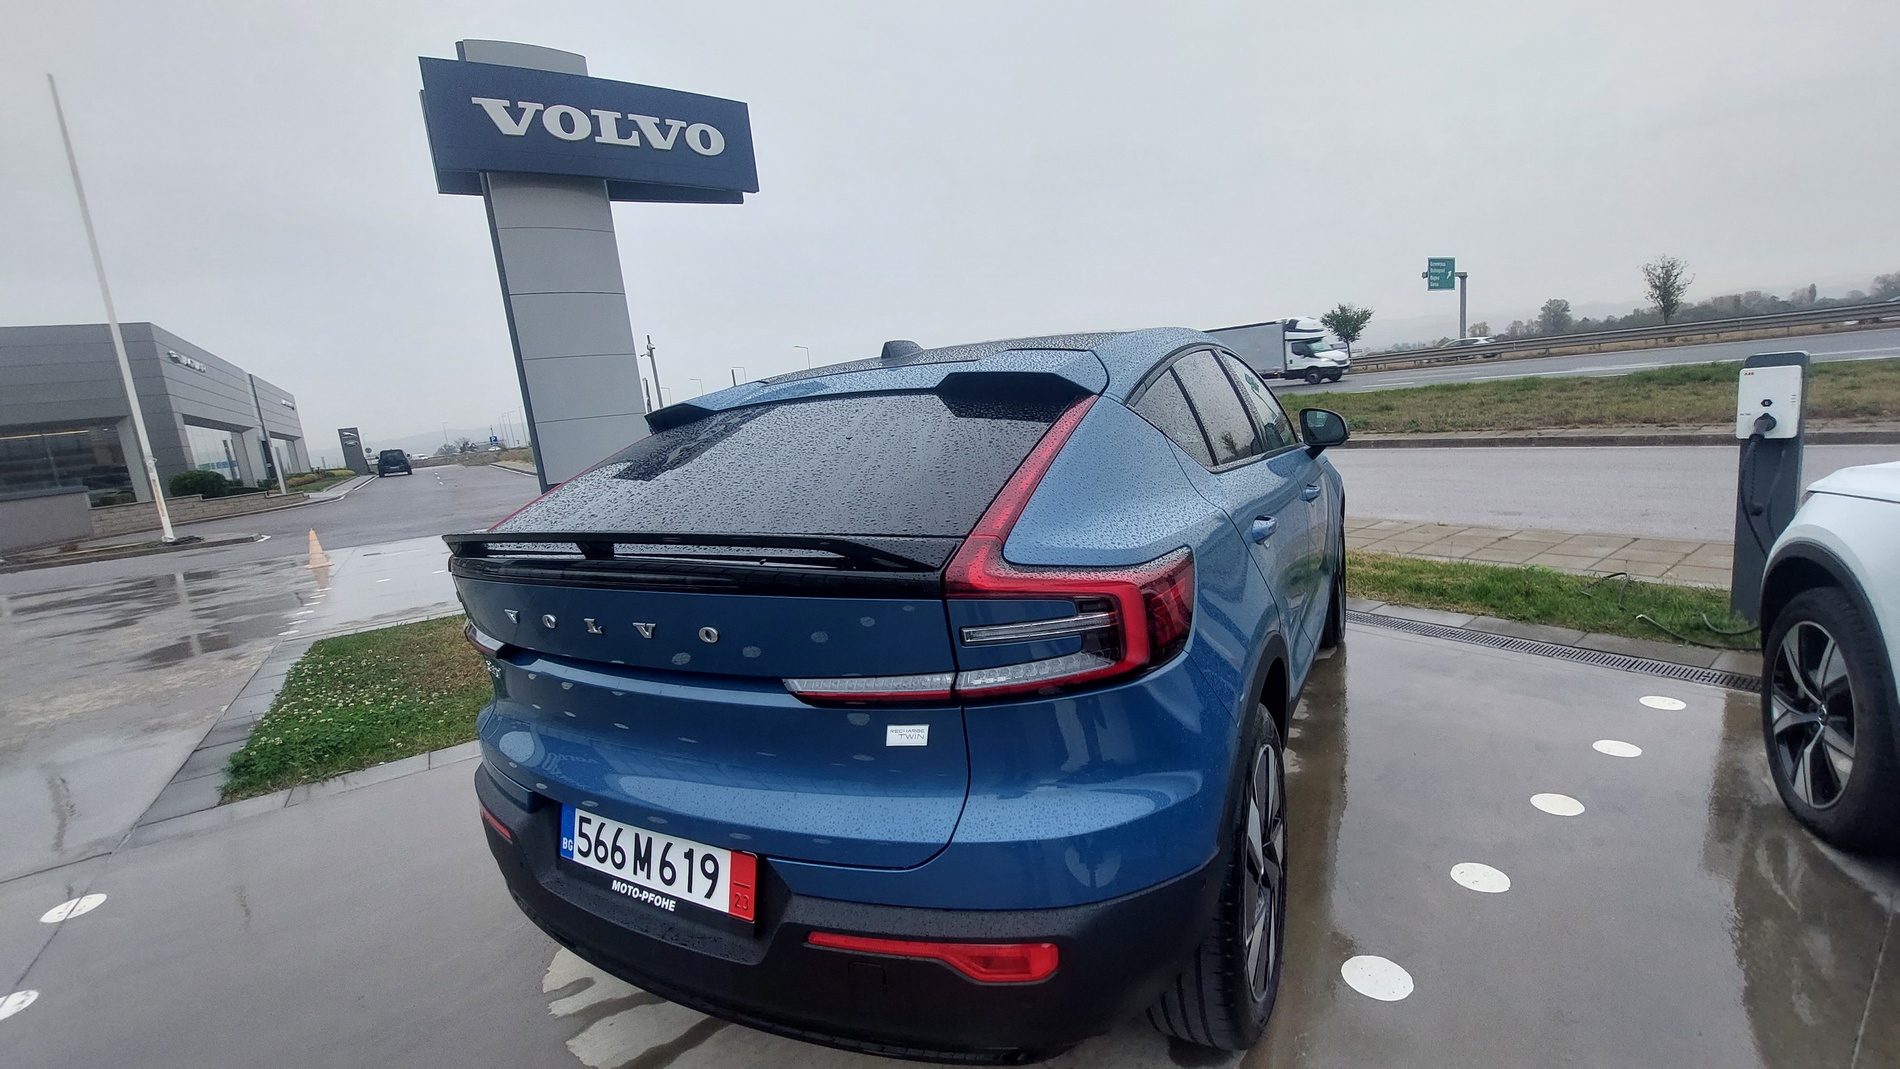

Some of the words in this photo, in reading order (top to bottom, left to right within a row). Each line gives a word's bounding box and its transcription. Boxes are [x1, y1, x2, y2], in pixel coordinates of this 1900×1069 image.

[471, 96, 726, 156] VOLVO
[504, 609, 719, 644] VOLVO
[562, 837, 573, 851] BG
[733, 892, 750, 911] 23
[611, 879, 676, 912] MOTO-PFOHE
